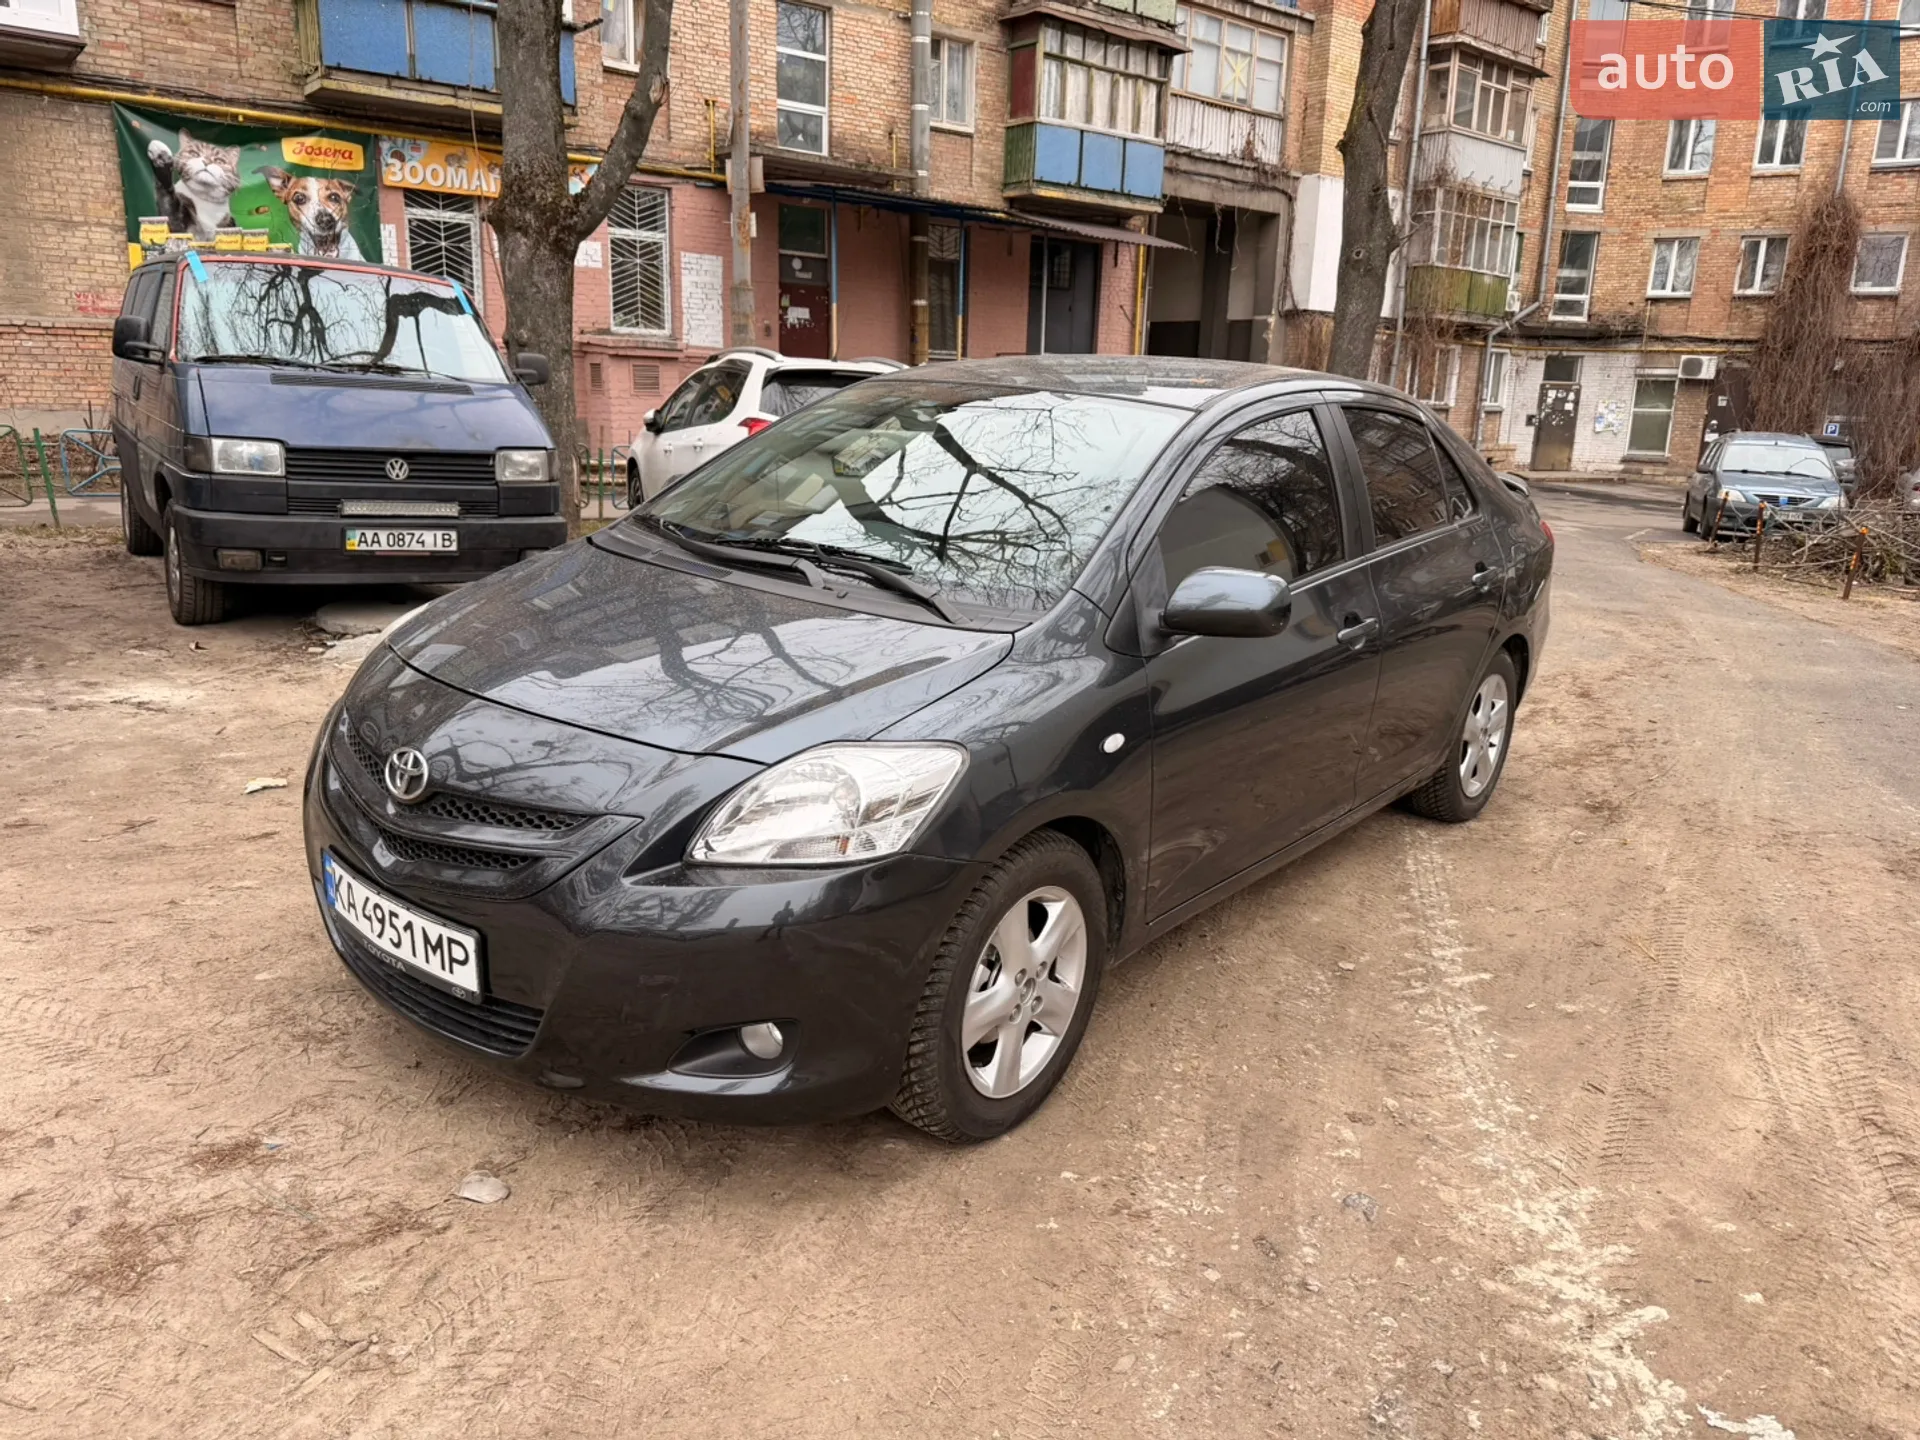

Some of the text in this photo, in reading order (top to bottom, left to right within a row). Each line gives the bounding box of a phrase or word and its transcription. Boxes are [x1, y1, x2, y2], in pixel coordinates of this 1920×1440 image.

[292, 141, 354, 160] Josera
[357, 532, 453, 548] AA 0874 IB
[362, 896, 418, 958] 4951
[422, 926, 470, 974] MP
[362, 939, 407, 972] TOYOTA
